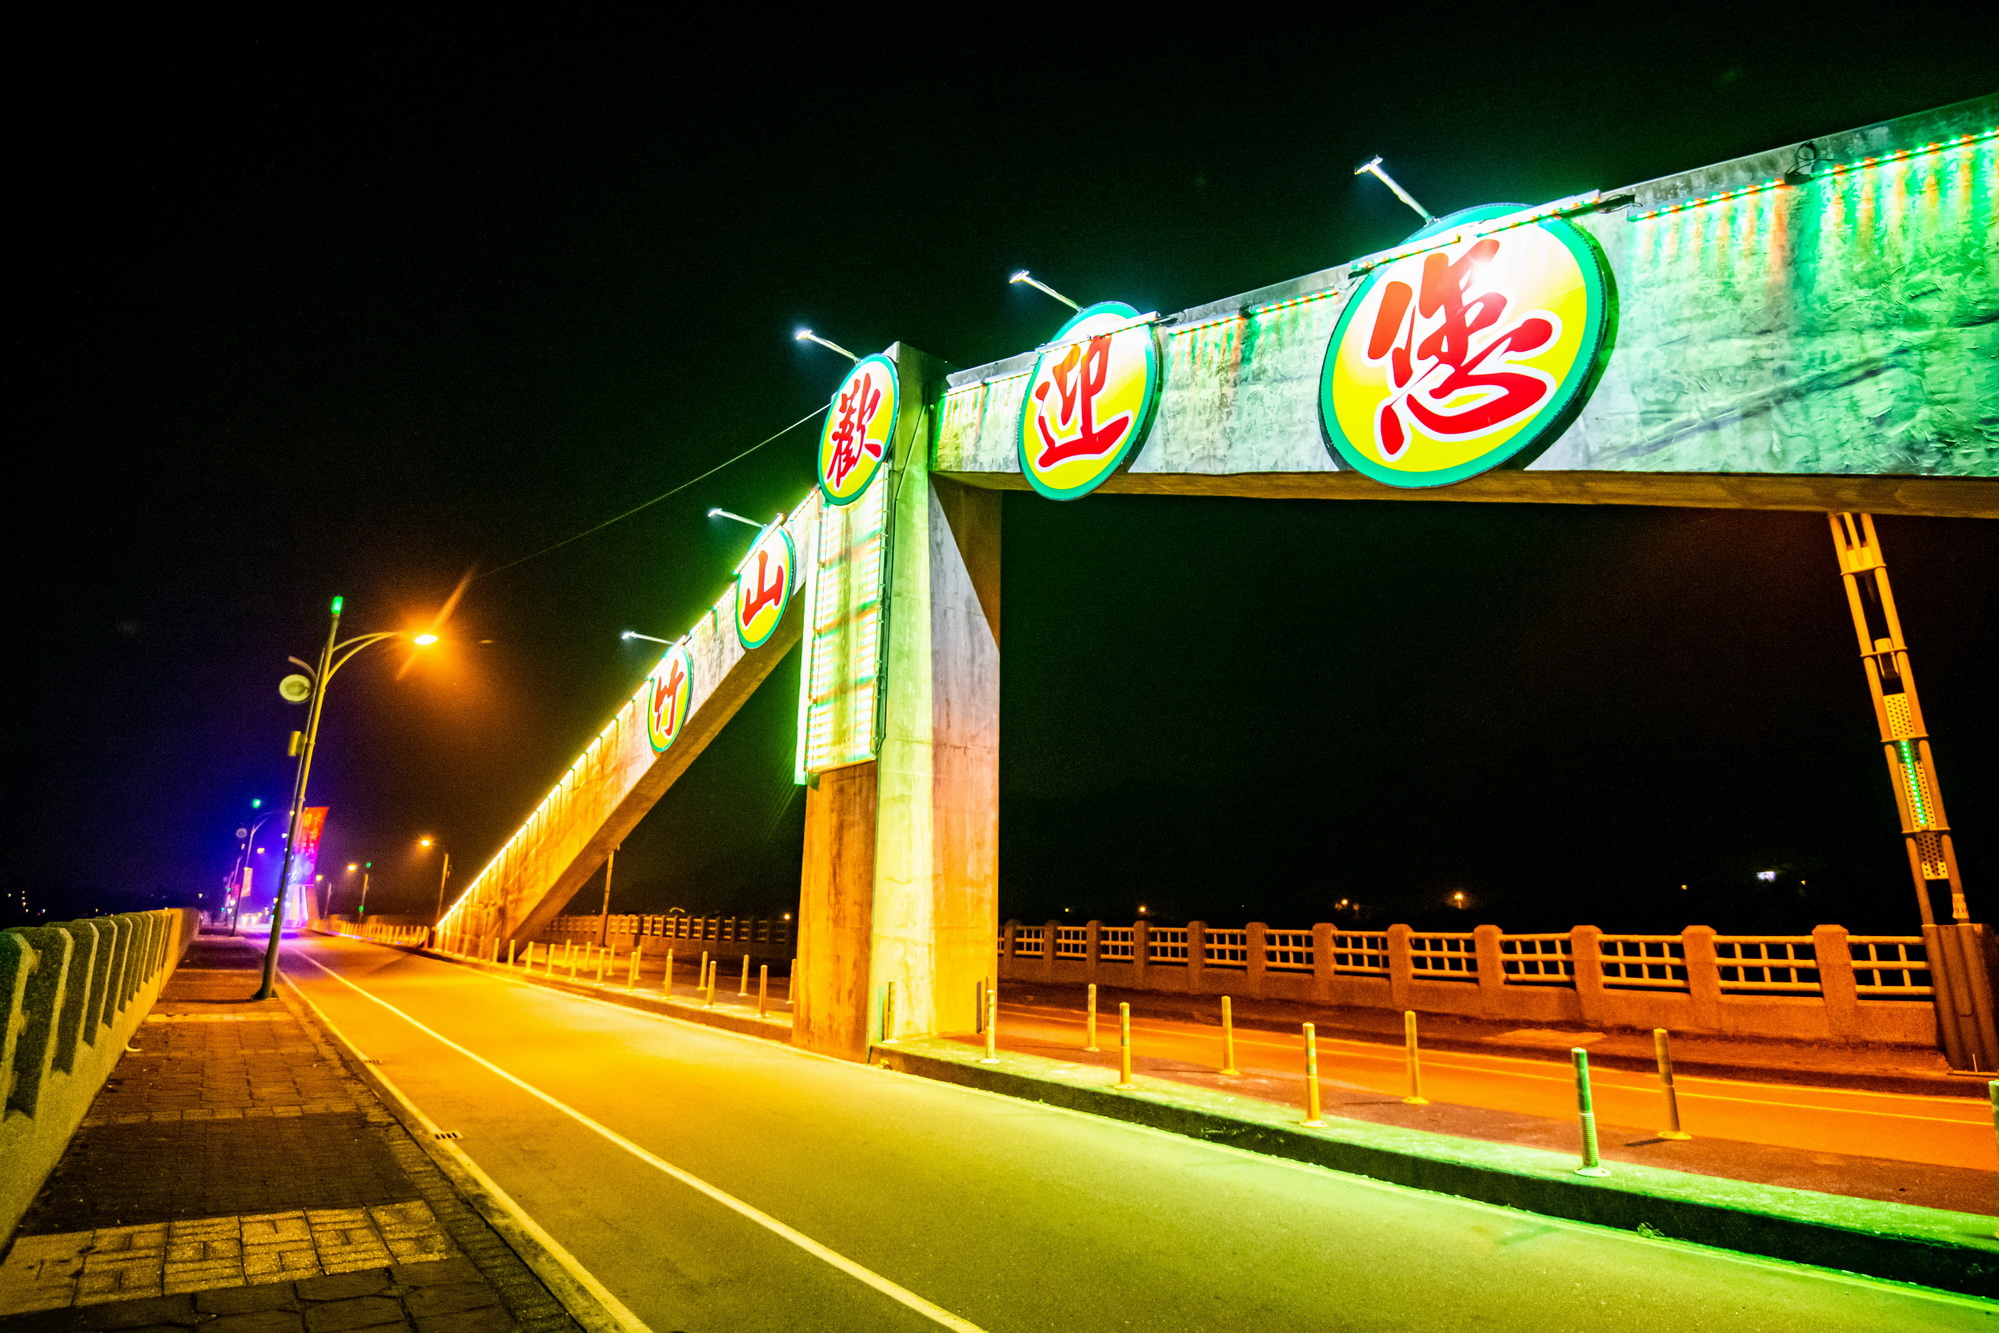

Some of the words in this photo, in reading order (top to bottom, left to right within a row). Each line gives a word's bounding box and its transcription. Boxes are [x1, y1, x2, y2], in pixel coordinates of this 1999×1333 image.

[1035, 336, 1130, 468] 迎
[1367, 238, 1553, 456] 您
[827, 373, 882, 488] 歡
[742, 550, 784, 627] 山
[654, 660, 684, 736] 竹
